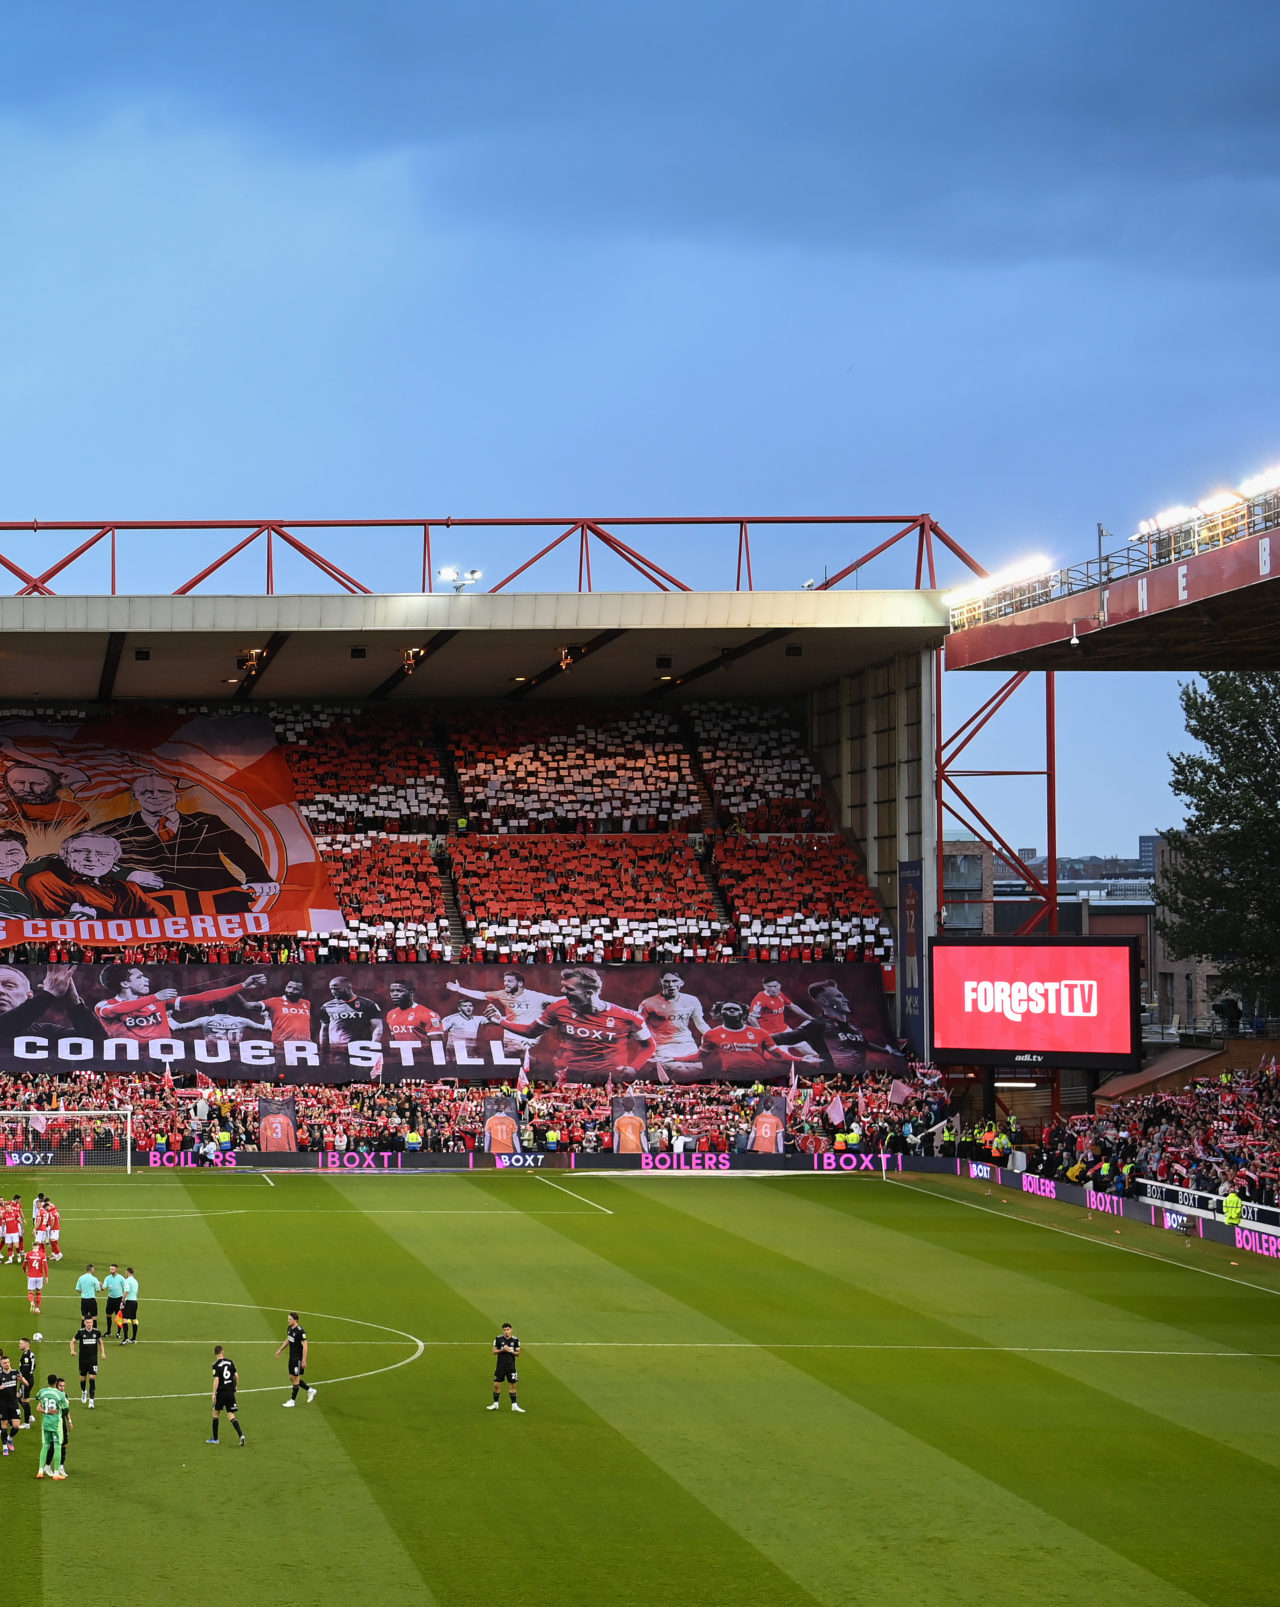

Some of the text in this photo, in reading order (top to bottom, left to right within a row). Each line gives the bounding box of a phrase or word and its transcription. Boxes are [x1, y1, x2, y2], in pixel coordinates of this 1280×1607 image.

[22, 912, 270, 942] CONQUERED
[509, 1002, 530, 1010] OXT
[1063, 983, 1095, 1014] TV
[125, 1012, 162, 1027] BOXT
[281, 1007, 311, 1016] BOXT
[565, 1024, 617, 1042] BOXT
[13, 1035, 320, 1066] CONQUER
[347, 1039, 522, 1067] STILL
[1014, 1053, 1044, 1062] adi.tv
[271, 1122, 282, 1138] 3
[761, 1123, 771, 1138] 6
[11, 1152, 55, 1166] BOXT
[149, 1151, 237, 1168] BOILRS
[327, 1151, 393, 1168] BOXT
[501, 1154, 545, 1168] BOXT
[641, 1152, 730, 1170] BOILERS
[823, 1152, 892, 1170] BOXT
[972, 1163, 991, 1179] BOXT
[1022, 1173, 1056, 1199] BOILERS
[1146, 1185, 1167, 1201] BOXT
[1090, 1190, 1119, 1216] BOXT
[1178, 1191, 1199, 1208] BOXT
[1241, 1205, 1259, 1222] OXT
[31, 1260, 40, 1270] 4
[222, 1366, 231, 1380] 6
